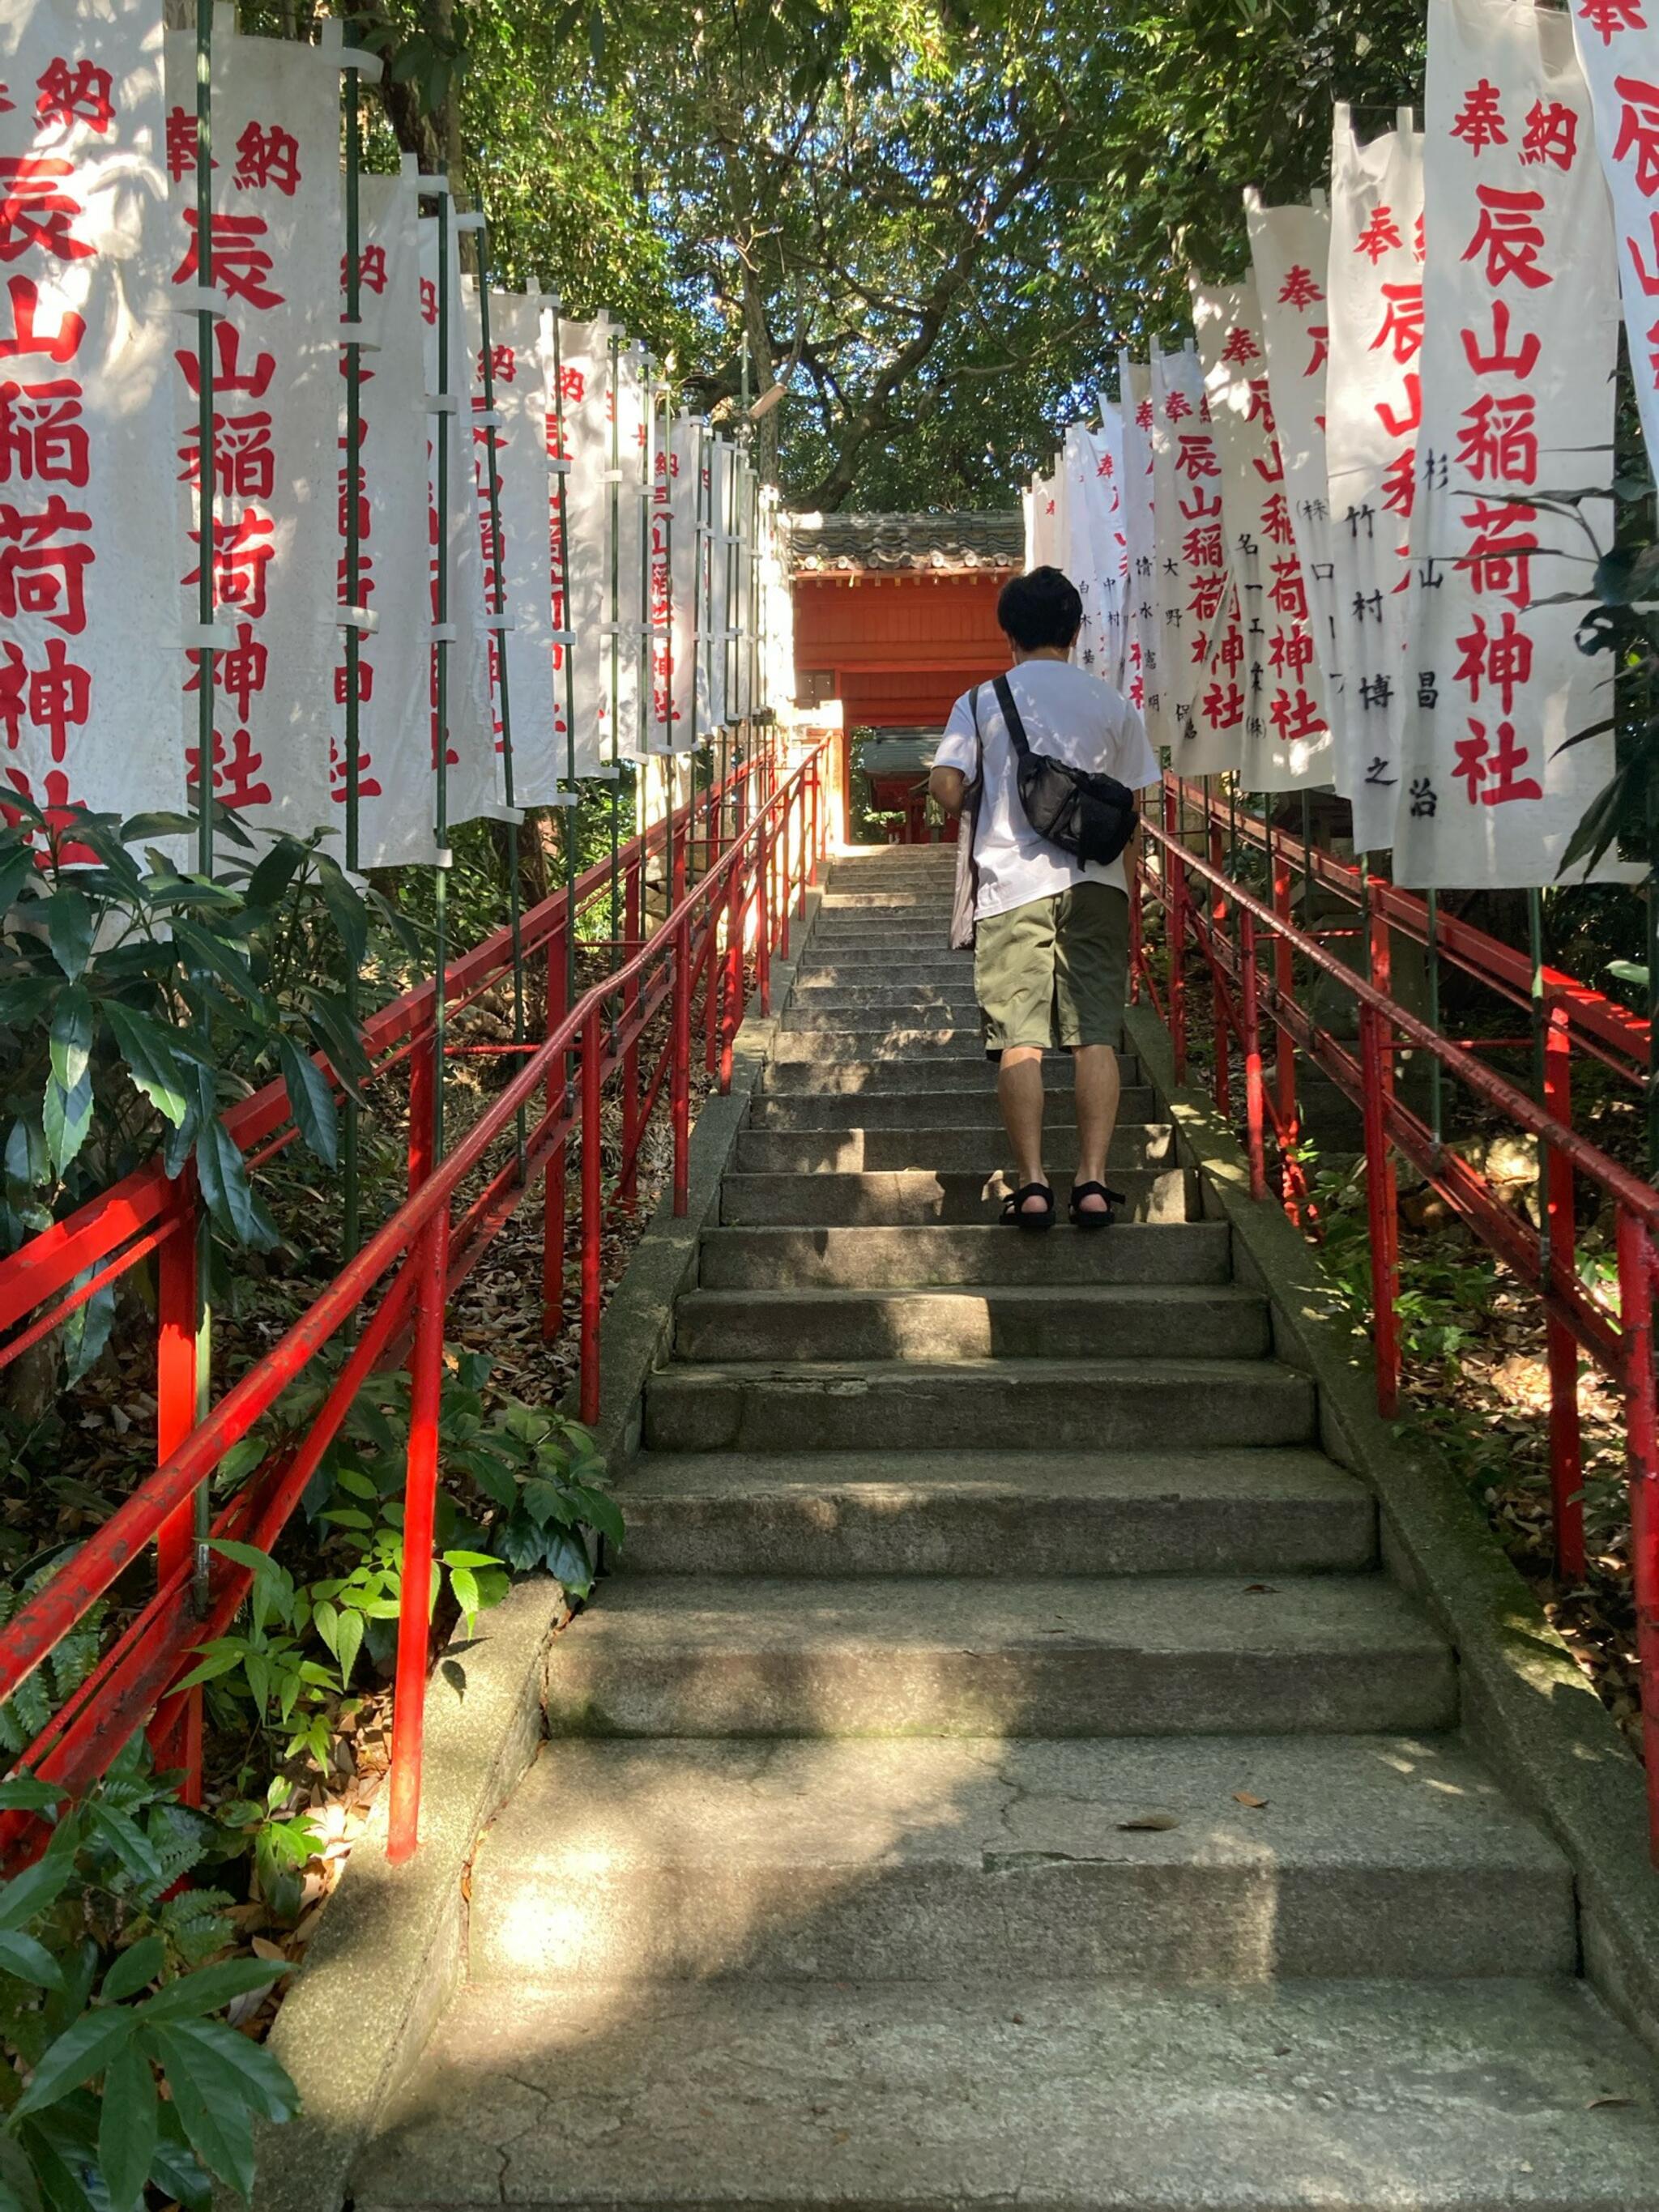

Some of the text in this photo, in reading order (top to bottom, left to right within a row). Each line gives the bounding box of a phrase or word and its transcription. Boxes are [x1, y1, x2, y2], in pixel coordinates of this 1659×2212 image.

[0, 58, 116, 134] 納
[1449, 78, 1578, 171] 奉納
[166, 106, 301, 196] 奉納
[1353, 201, 1425, 266] 奉
[1277, 264, 1326, 313] 奉
[1221, 327, 1260, 366] 奉
[171, 207, 286, 809] 辰山稲荷神社
[1450, 184, 1554, 806] 辰山稲荷神社
[1175, 435, 1244, 731] 辰山稲荷神社
[1345, 504, 1398, 786] 竹村博之
[1410, 448, 1449, 818] 杉山昌治
